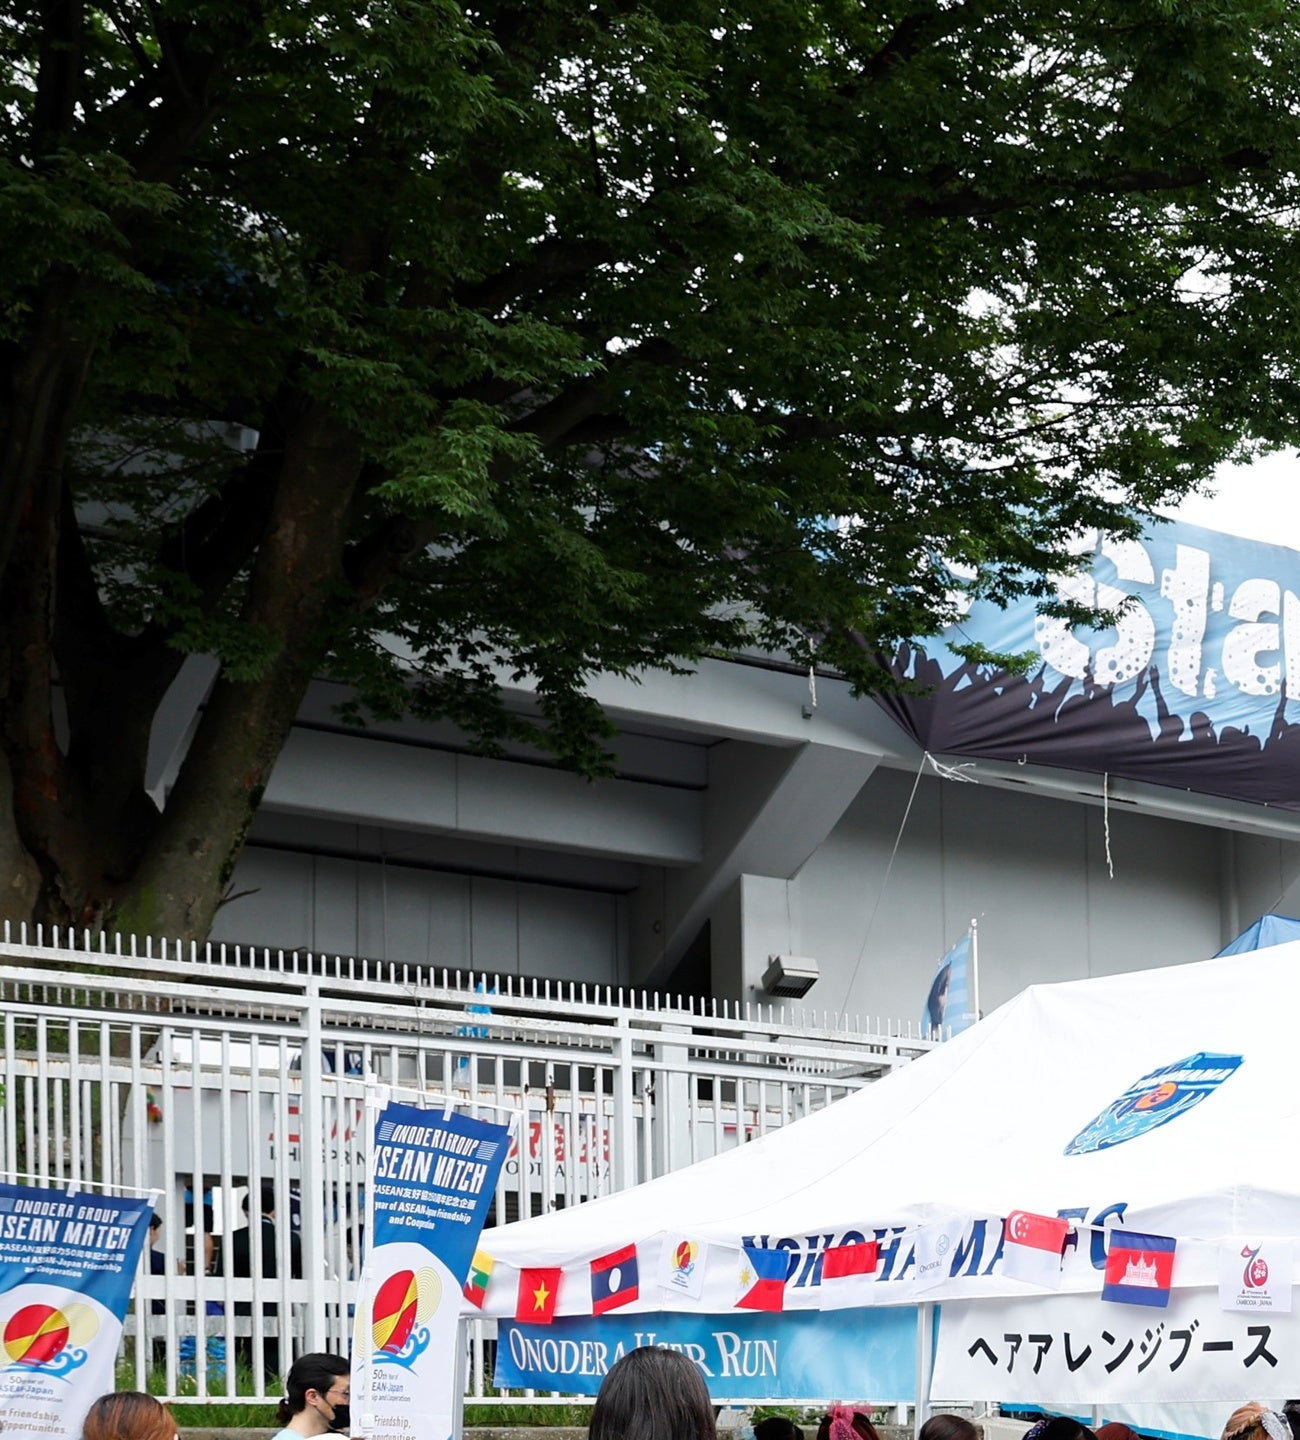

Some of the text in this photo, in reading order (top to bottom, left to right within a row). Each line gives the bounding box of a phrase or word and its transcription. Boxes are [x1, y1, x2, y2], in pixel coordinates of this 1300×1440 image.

[14, 1199, 119, 1224] ONODERA GROUP
[62, 1221, 132, 1250] MATCH
[712, 1331, 777, 1377] RUN
[967, 1319, 1279, 1374] ヘアアレンジブース
